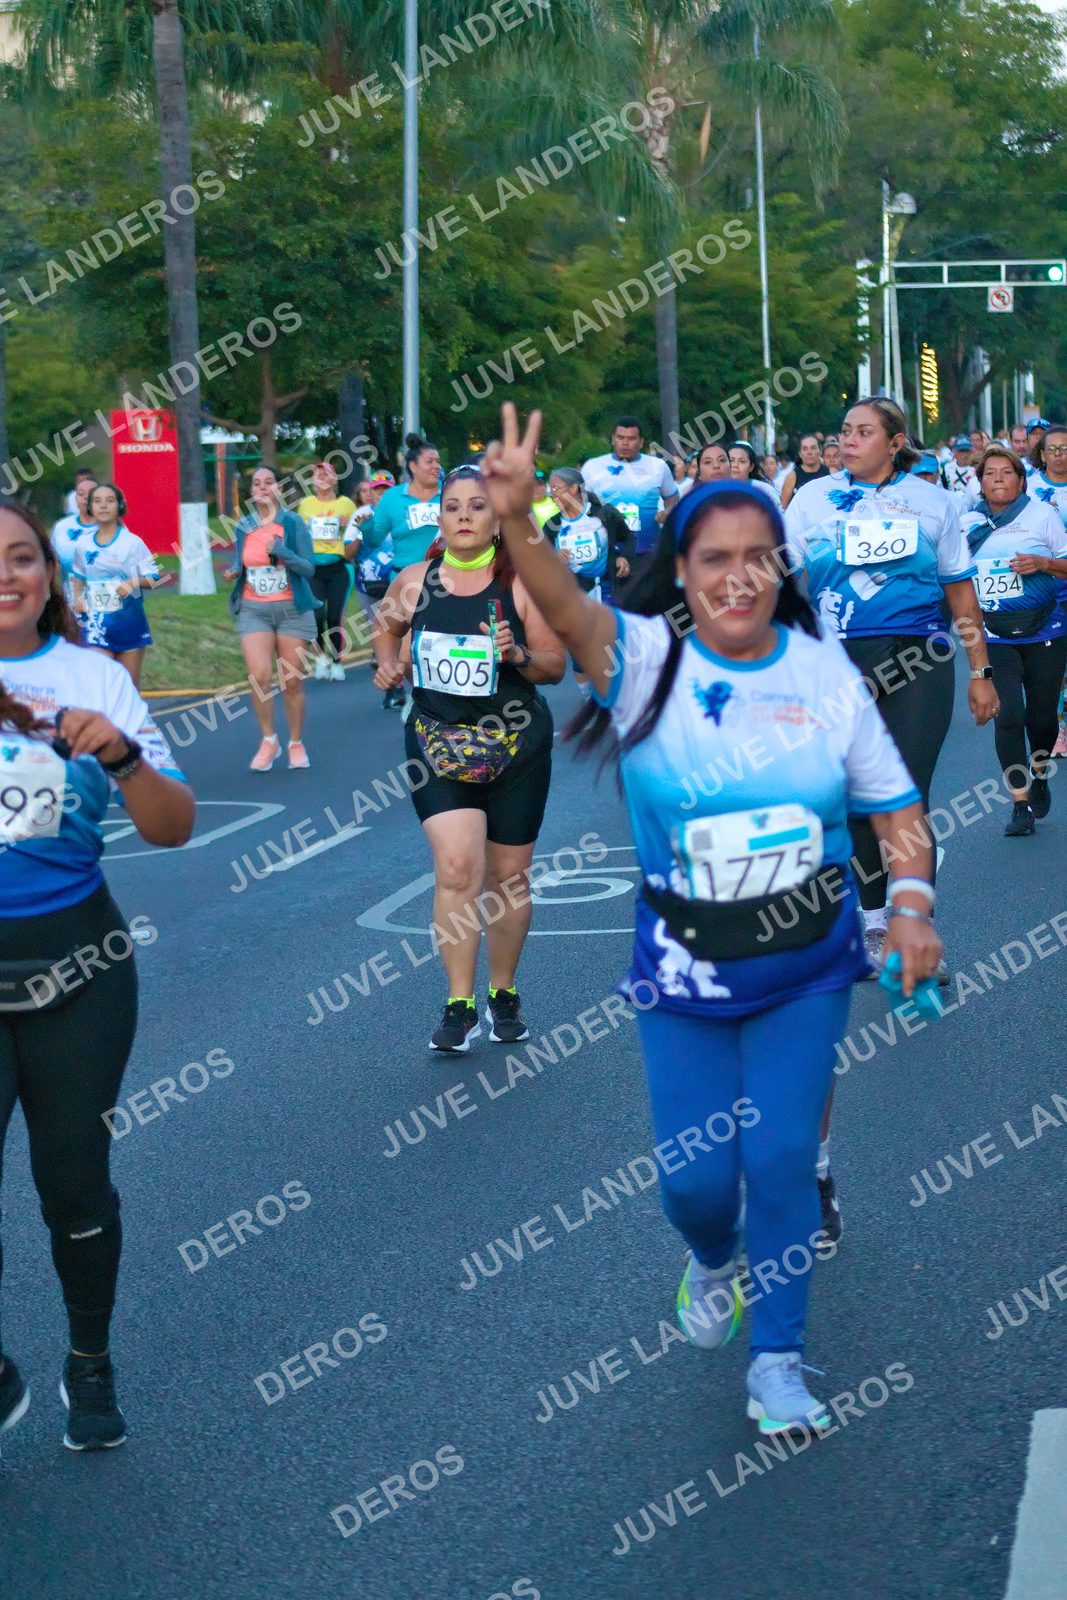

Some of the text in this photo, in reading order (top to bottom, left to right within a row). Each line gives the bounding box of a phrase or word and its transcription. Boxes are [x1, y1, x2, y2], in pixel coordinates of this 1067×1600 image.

[117, 443, 176, 454] HONDA
[857, 538, 907, 559] 360
[253, 576, 287, 593] 1876
[974, 575, 1021, 595] 1254
[423, 657, 490, 688] 1005
[703, 846, 812, 900] 1775
